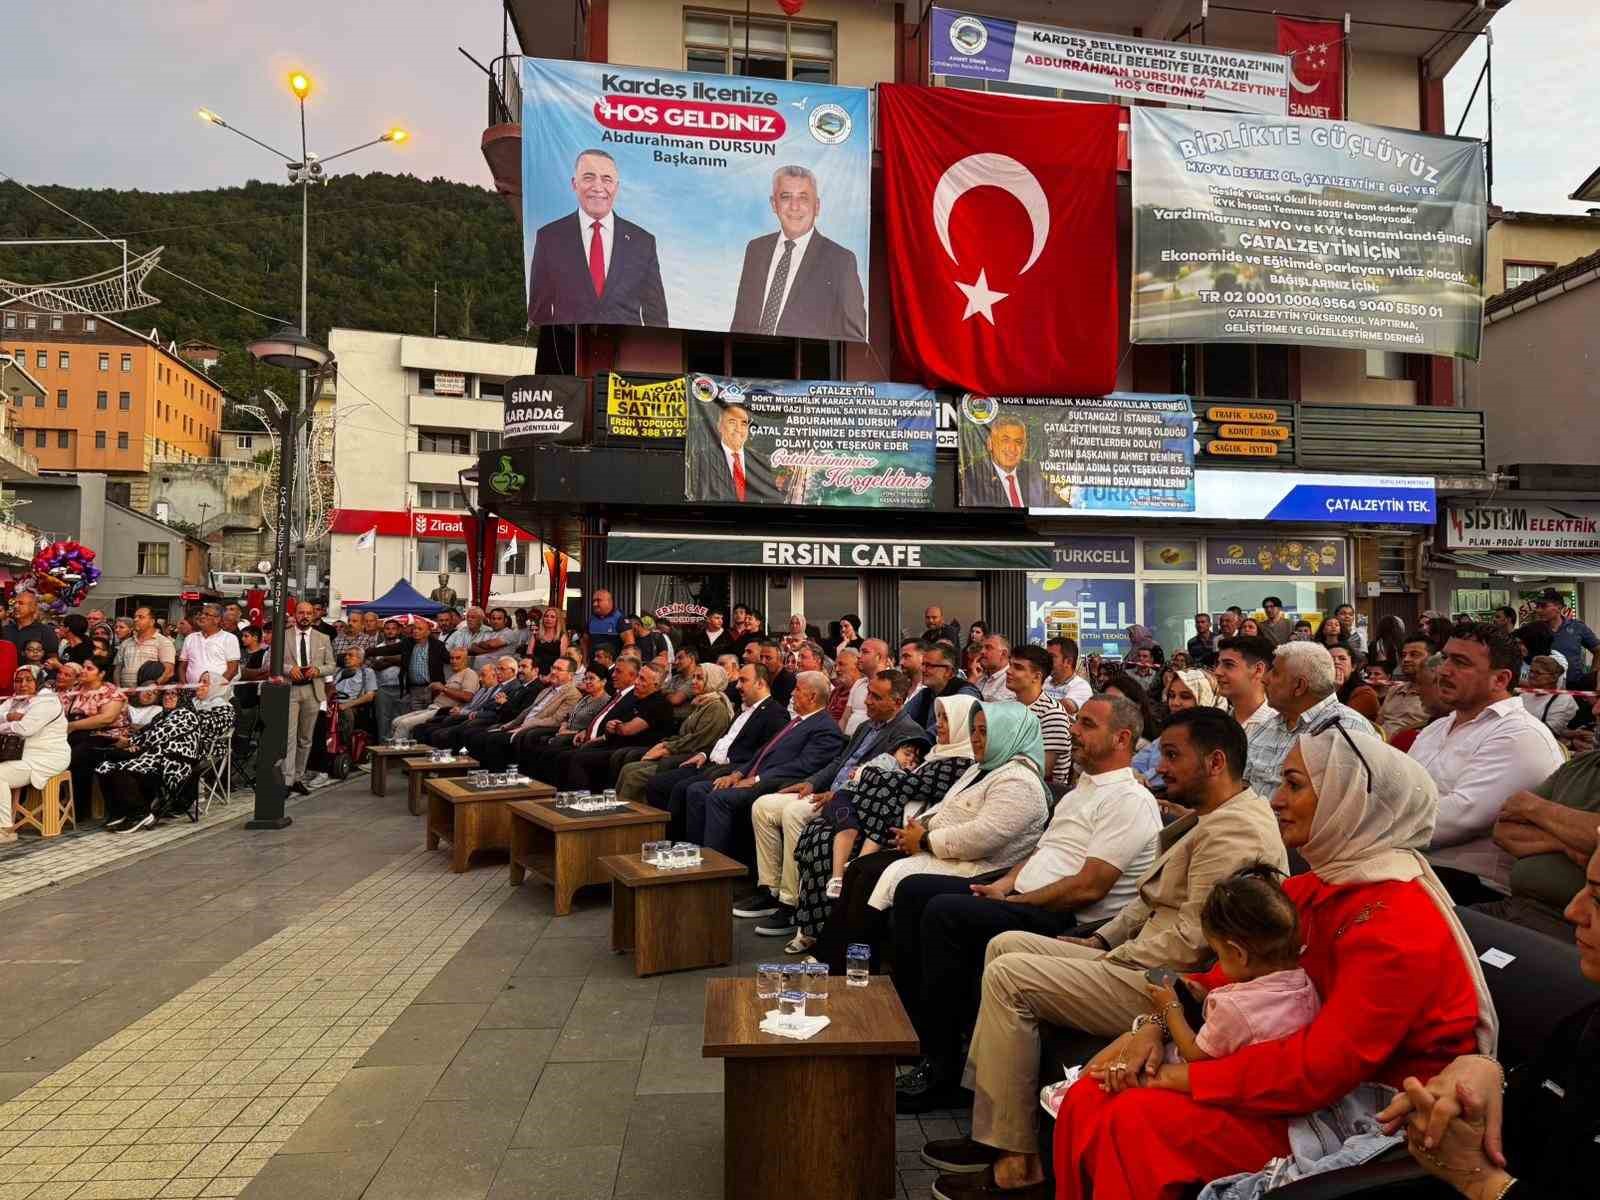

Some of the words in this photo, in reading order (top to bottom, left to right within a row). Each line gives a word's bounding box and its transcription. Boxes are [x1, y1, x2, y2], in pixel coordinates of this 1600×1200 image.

[1032, 32, 1087, 49] KARDEŞ
[1025, 55, 1129, 77] ABDURRAHMAN
[1133, 69, 1186, 85] DURSUN
[1067, 48, 1121, 64] DEĞERLİ
[1126, 57, 1188, 73] BELEDİYE
[1192, 65, 1249, 81] BAŞKANI
[602, 74, 687, 97] Kardeş
[693, 82, 778, 105] ilçenize
[1115, 80, 1142, 92] HOŞ
[1146, 83, 1207, 99] GELDİNİZ
[604, 103, 660, 125] HOŞ
[664, 109, 776, 133] GELDİNİZ
[1289, 104, 1330, 118] SAADET
[602, 130, 704, 149] Abdurahman
[709, 140, 776, 155] DURSUN
[654, 151, 728, 168] Başkanım
[1178, 121, 1300, 159] BİRLİKTE
[1311, 124, 1440, 184] GÜÇLÜYÜZ
[1186, 160, 1231, 176] MYO'YA
[1233, 167, 1279, 181] DESTEK
[1389, 183, 1410, 196] GÜÇ
[1209, 185, 1244, 198] Meslek
[1246, 190, 1282, 203] Yüksek
[1284, 195, 1306, 205] Okul
[1214, 197, 1236, 208] KYK
[1273, 205, 1315, 216] Temmuz
[1153, 208, 1255, 226] Yardımlarınız
[1258, 218, 1291, 230] MYO
[1295, 223, 1311, 233] ve
[1314, 224, 1345, 236] KYK
[1348, 227, 1472, 246] tamamlandığında
[1239, 233, 1360, 256] ÇATALZEYTİN
[1363, 241, 1401, 260] İÇİN
[1161, 250, 1242, 262] Ekonomide
[1245, 256, 1260, 264] ve
[1263, 254, 1322, 270] Eğitimde
[1325, 261, 1385, 276] parlayan
[1387, 266, 1424, 278] yıldız
[1200, 291, 1220, 303] TR
[1223, 291, 1243, 303] 02
[1246, 292, 1281, 305] 0001
[1284, 294, 1320, 307] 0004
[1322, 297, 1357, 310] 9564
[1359, 300, 1394, 313] 9040
[1396, 302, 1426, 316] 5550
[1429, 306, 1443, 318] 01
[1227, 308, 1300, 320] ÇATALZEYTİN
[1302, 311, 1366, 325] YÜKSEKOKUL
[1224, 322, 1288, 335] GELİŞTİRME
[1290, 325, 1303, 335] VE
[1305, 325, 1383, 342] GÜZELLEŞTİRME
[1384, 330, 1424, 345] DERNEĞİ
[511, 388, 553, 404] SİNAN
[809, 386, 875, 398] ÇATALZEYTİN
[505, 406, 564, 424] KARADAĞ
[617, 402, 684, 416] SATILIK
[751, 404, 782, 413] SULTAN
[803, 406, 842, 416] İSTANBUL
[843, 407, 867, 416] SAYIN
[786, 416, 855, 427] ABDURAHMAN
[857, 418, 898, 427] DURSUN
[612, 426, 638, 436] 0506
[641, 428, 660, 437] 388
[663, 428, 673, 437] 17
[749, 425, 781, 437] ÇATAL
[848, 429, 932, 440] DESTEKLERİNDEN
[775, 438, 811, 449] DOLAYI
[813, 440, 834, 450] ÇOK
[884, 442, 909, 451] EDER
[1070, 438, 1131, 448] HİZMETLERDEN
[1133, 439, 1162, 449] DOLAYI
[1048, 449, 1073, 458] SAYIN
[1120, 451, 1149, 461] AHMET
[1086, 462, 1111, 473] ADINA
[1113, 463, 1130, 475] ÇOK
[1325, 497, 1404, 514] ÇATALZEYTİN
[1407, 500, 1431, 513] TEK.
[430, 519, 464, 532] Ziraat
[1529, 516, 1597, 533] ELEKTRİK
[1468, 537, 1491, 546] PLAN
[1528, 538, 1551, 547] UYDU
[762, 541, 842, 566] ERSİN
[851, 544, 922, 567] CAFE
[1053, 549, 1130, 564] TURKCELL
[1215, 557, 1257, 565] TURKCELL
